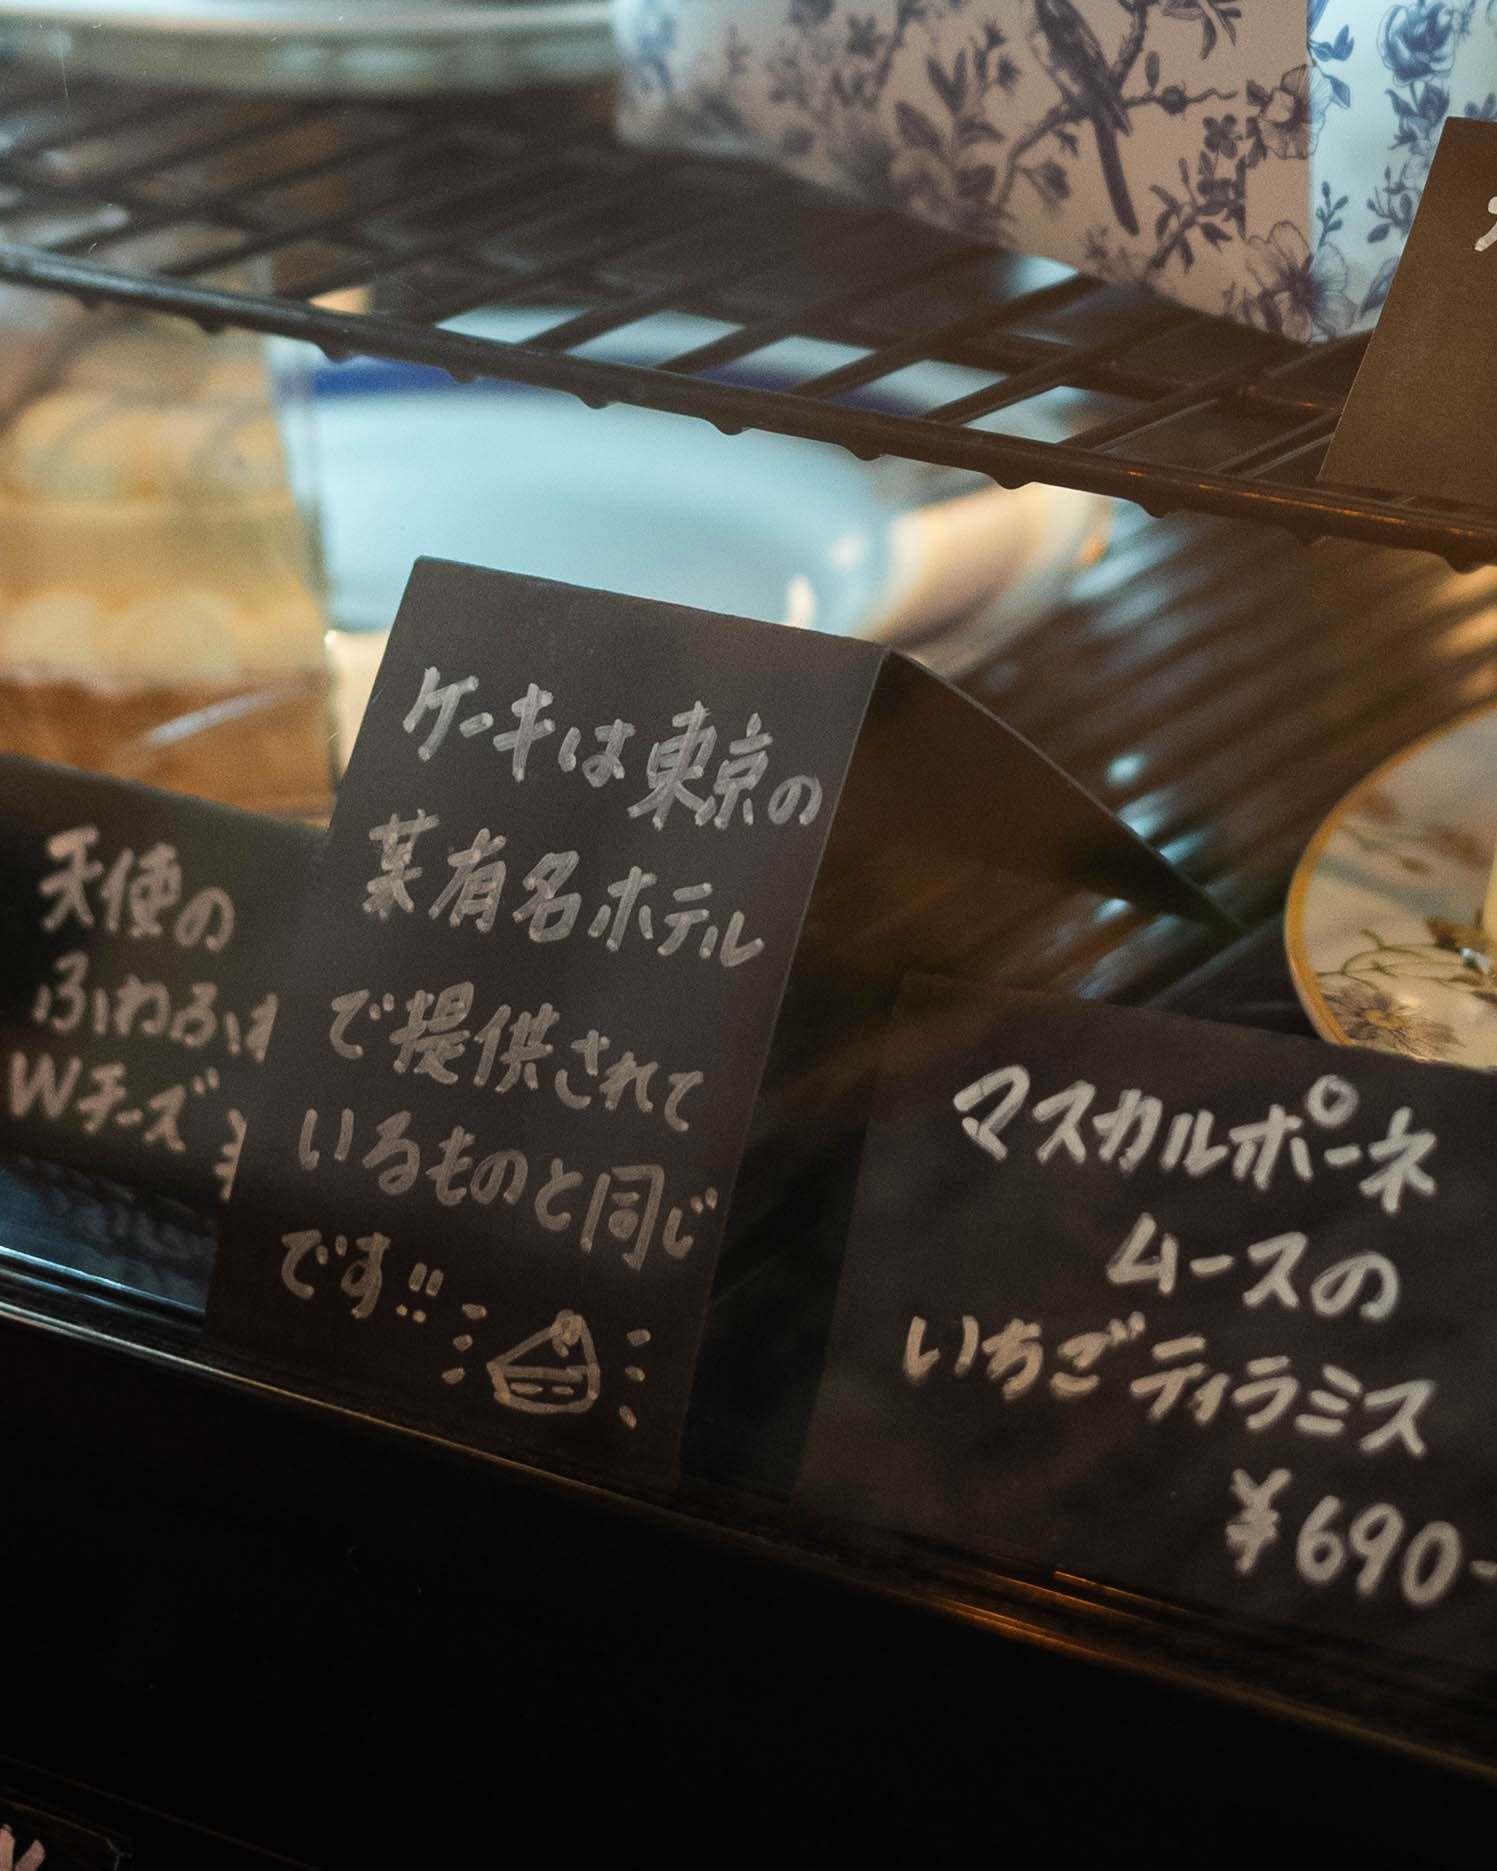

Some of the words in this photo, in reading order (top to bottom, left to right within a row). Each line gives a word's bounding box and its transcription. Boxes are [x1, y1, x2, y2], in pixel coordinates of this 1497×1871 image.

[403, 666, 822, 830] ケーキは東京の
[42, 827, 234, 952] 天使の
[362, 809, 764, 967] 某有名ホテル
[10, 1050, 220, 1152] Wチーズ
[330, 989, 703, 1131] で提供されて
[299, 1108, 717, 1270] いるものと同じ
[953, 1066, 1436, 1213] マスカルポーネ
[1108, 1213, 1398, 1320] ムースの
